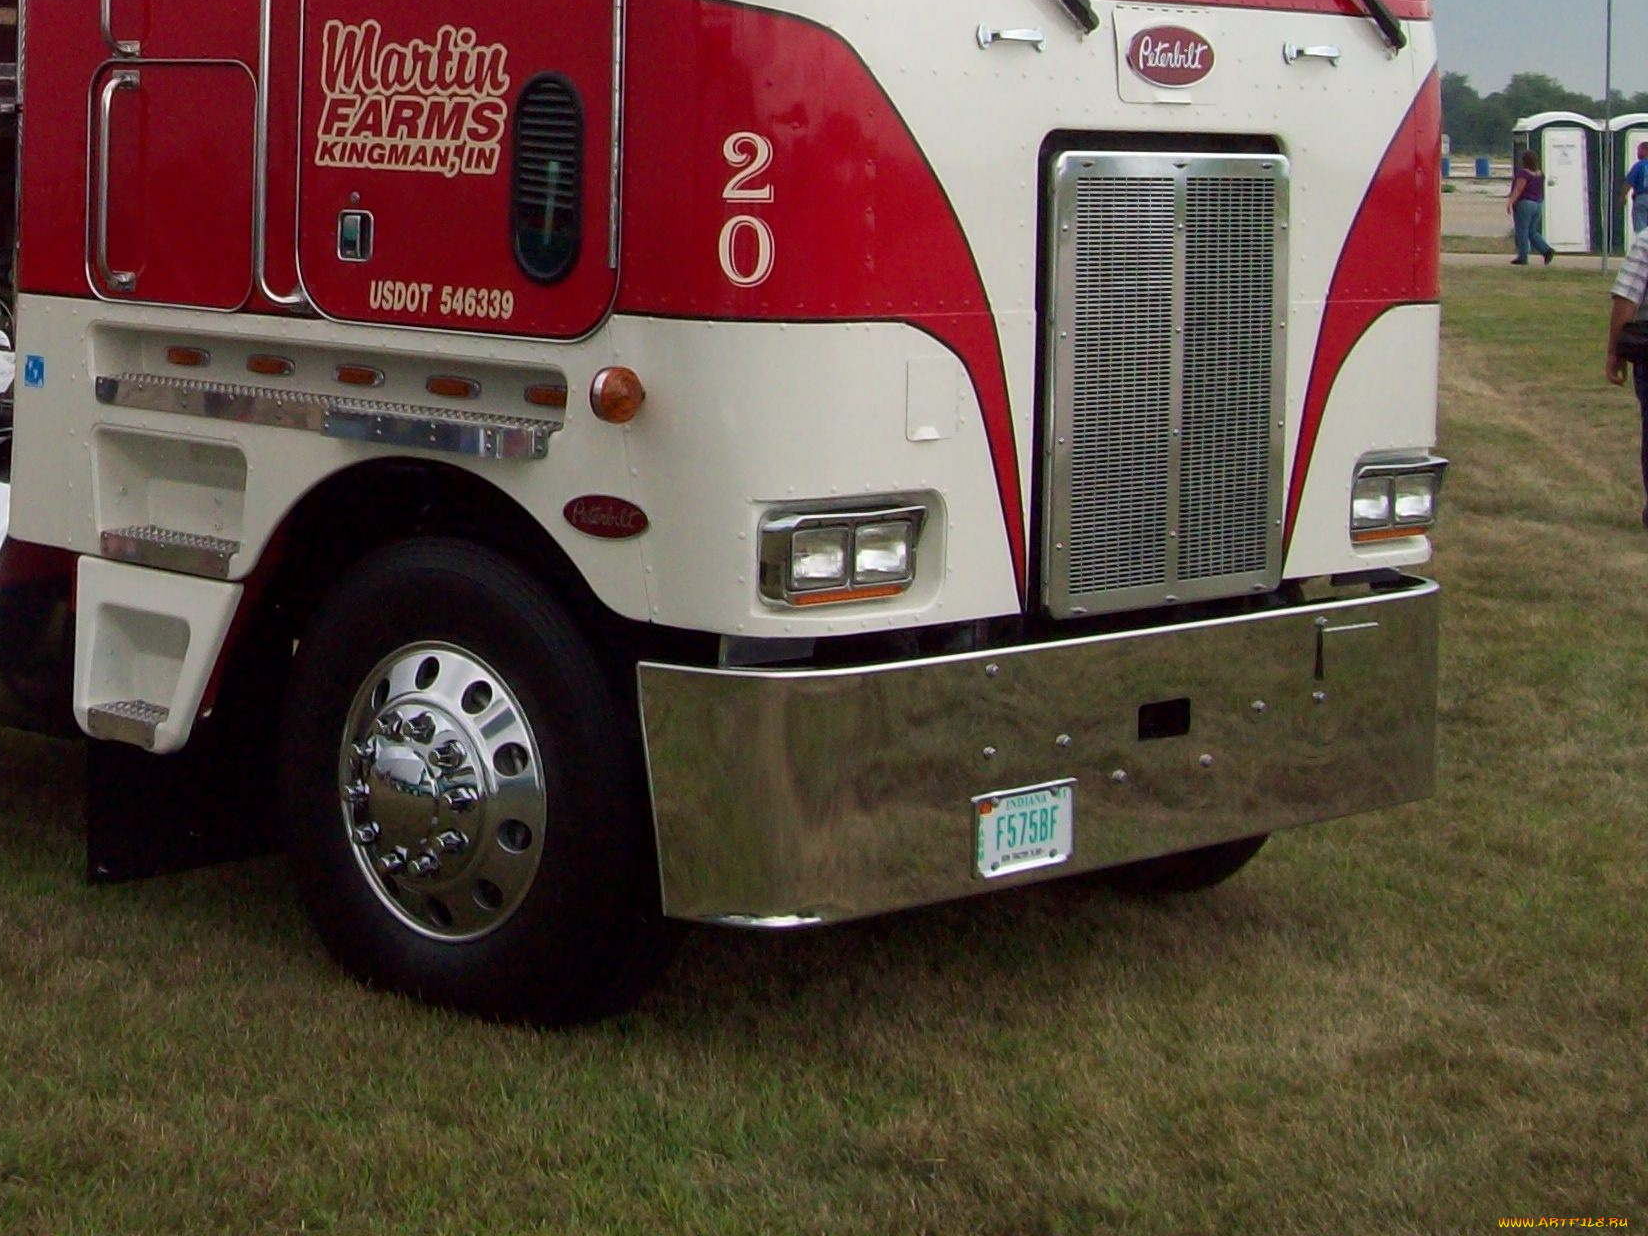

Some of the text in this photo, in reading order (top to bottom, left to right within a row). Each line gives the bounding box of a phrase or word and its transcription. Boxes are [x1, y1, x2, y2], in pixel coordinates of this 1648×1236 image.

[320, 19, 510, 97] Martin
[1138, 35, 1209, 70] Peterbilt
[317, 95, 508, 143] FARMS
[315, 141, 500, 177] KINGMAN, IN
[369, 280, 514, 320] USDOT 546339
[1006, 794, 1049, 811] INDIANA
[995, 805, 1060, 851] F575BF
